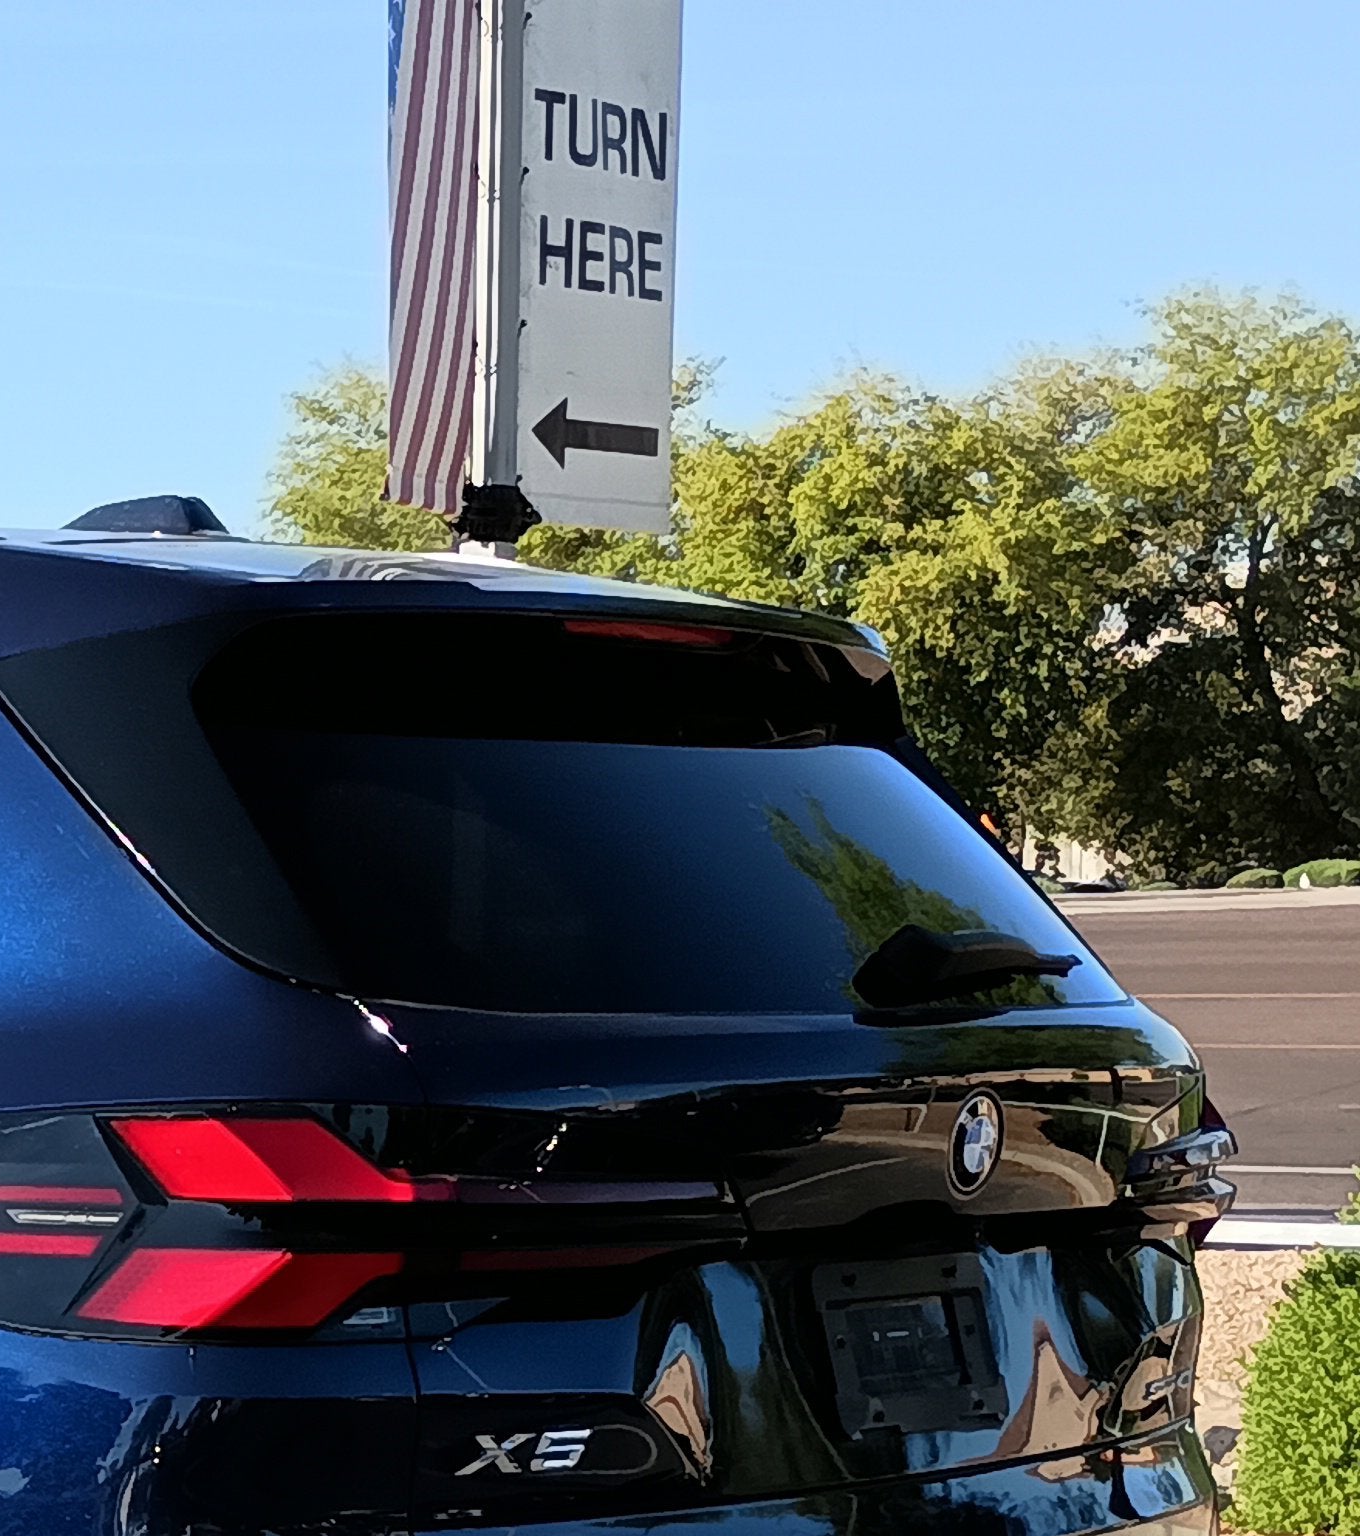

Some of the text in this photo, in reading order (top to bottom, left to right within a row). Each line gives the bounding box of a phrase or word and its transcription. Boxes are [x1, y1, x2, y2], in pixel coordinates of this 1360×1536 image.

[535, 88, 668, 181] TURN
[539, 214, 663, 301] HERE
[454, 1429, 593, 1476] X5
